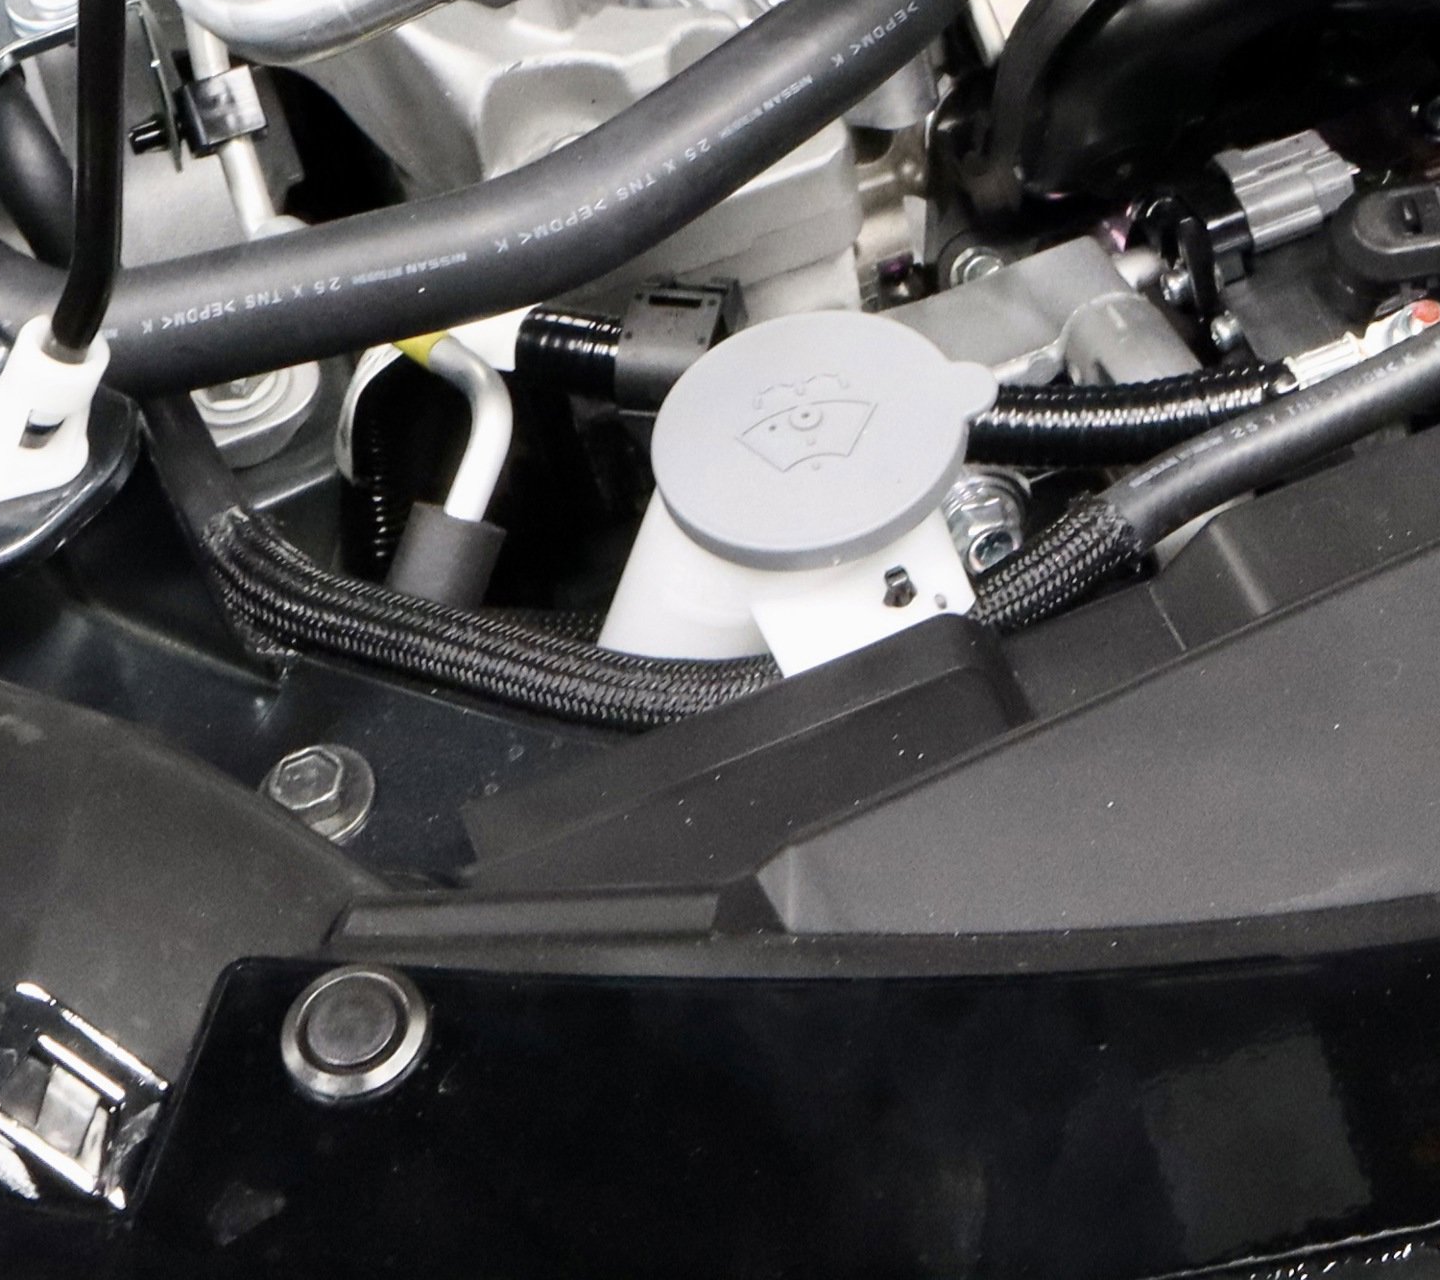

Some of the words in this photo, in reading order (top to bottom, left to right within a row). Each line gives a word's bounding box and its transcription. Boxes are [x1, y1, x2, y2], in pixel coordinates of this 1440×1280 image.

[684, 138, 711, 161] 25
[616, 172, 657, 201] TNS
[495, 239, 509, 253] K
[313, 276, 342, 295] 25
[245, 290, 283, 309] TNS
[142, 320, 153, 334] K
